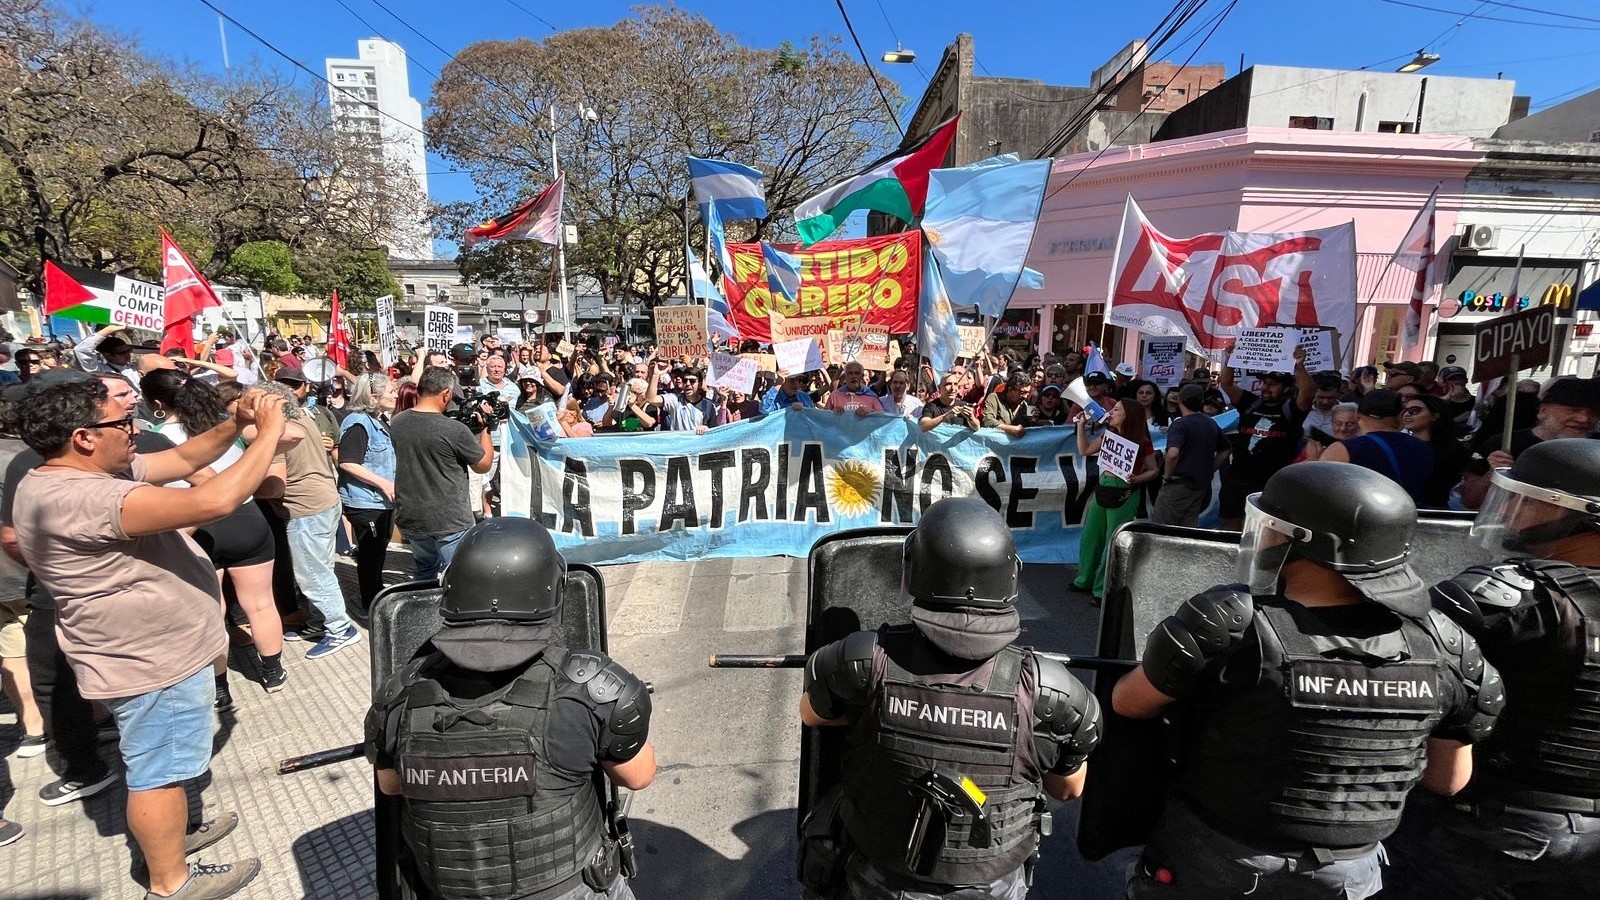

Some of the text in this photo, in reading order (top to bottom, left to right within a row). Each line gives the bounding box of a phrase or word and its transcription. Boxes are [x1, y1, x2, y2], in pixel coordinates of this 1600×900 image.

[130, 283, 164, 301] MILE
[1113, 222, 1322, 350] MST
[118, 295, 163, 317] COMPL
[672, 310, 693, 318] PLATA
[114, 310, 161, 331] GENOC
[429, 311, 454, 323] DERE
[428, 322, 454, 333] CHOS
[1477, 312, 1552, 361] CIPAYO
[428, 338, 453, 349] DERE
[660, 344, 707, 358] JUBILADOS
[1150, 364, 1176, 376] MST
[1103, 436, 1135, 463] MILEI SE
[1114, 457, 1124, 469] QUE
[527, 446, 595, 537] LA
[618, 443, 831, 535] PATRIA
[881, 447, 953, 523] NO
[974, 456, 1039, 527] SE
[1299, 675, 1434, 698] INFANTERIA
[888, 696, 1007, 731] INFANTERIA
[406, 766, 529, 786] INFANTERIA
